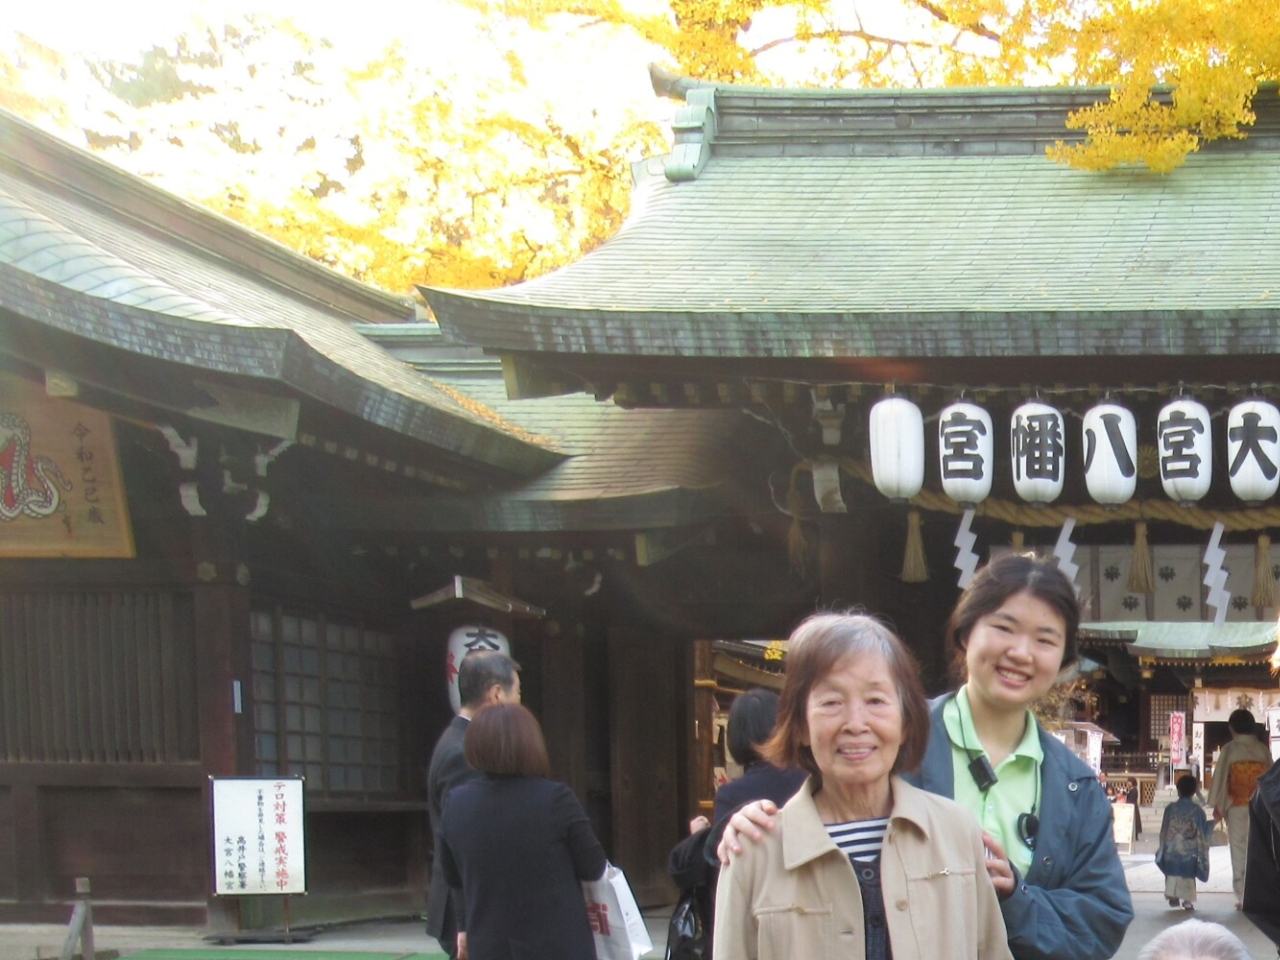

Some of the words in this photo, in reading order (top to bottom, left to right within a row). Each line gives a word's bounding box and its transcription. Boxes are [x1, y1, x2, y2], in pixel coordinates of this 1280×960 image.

[274, 781, 287, 824] テロ対策
[224, 836, 234, 890] 大宮八幡宮
[275, 831, 289, 891] 警戒実施中
